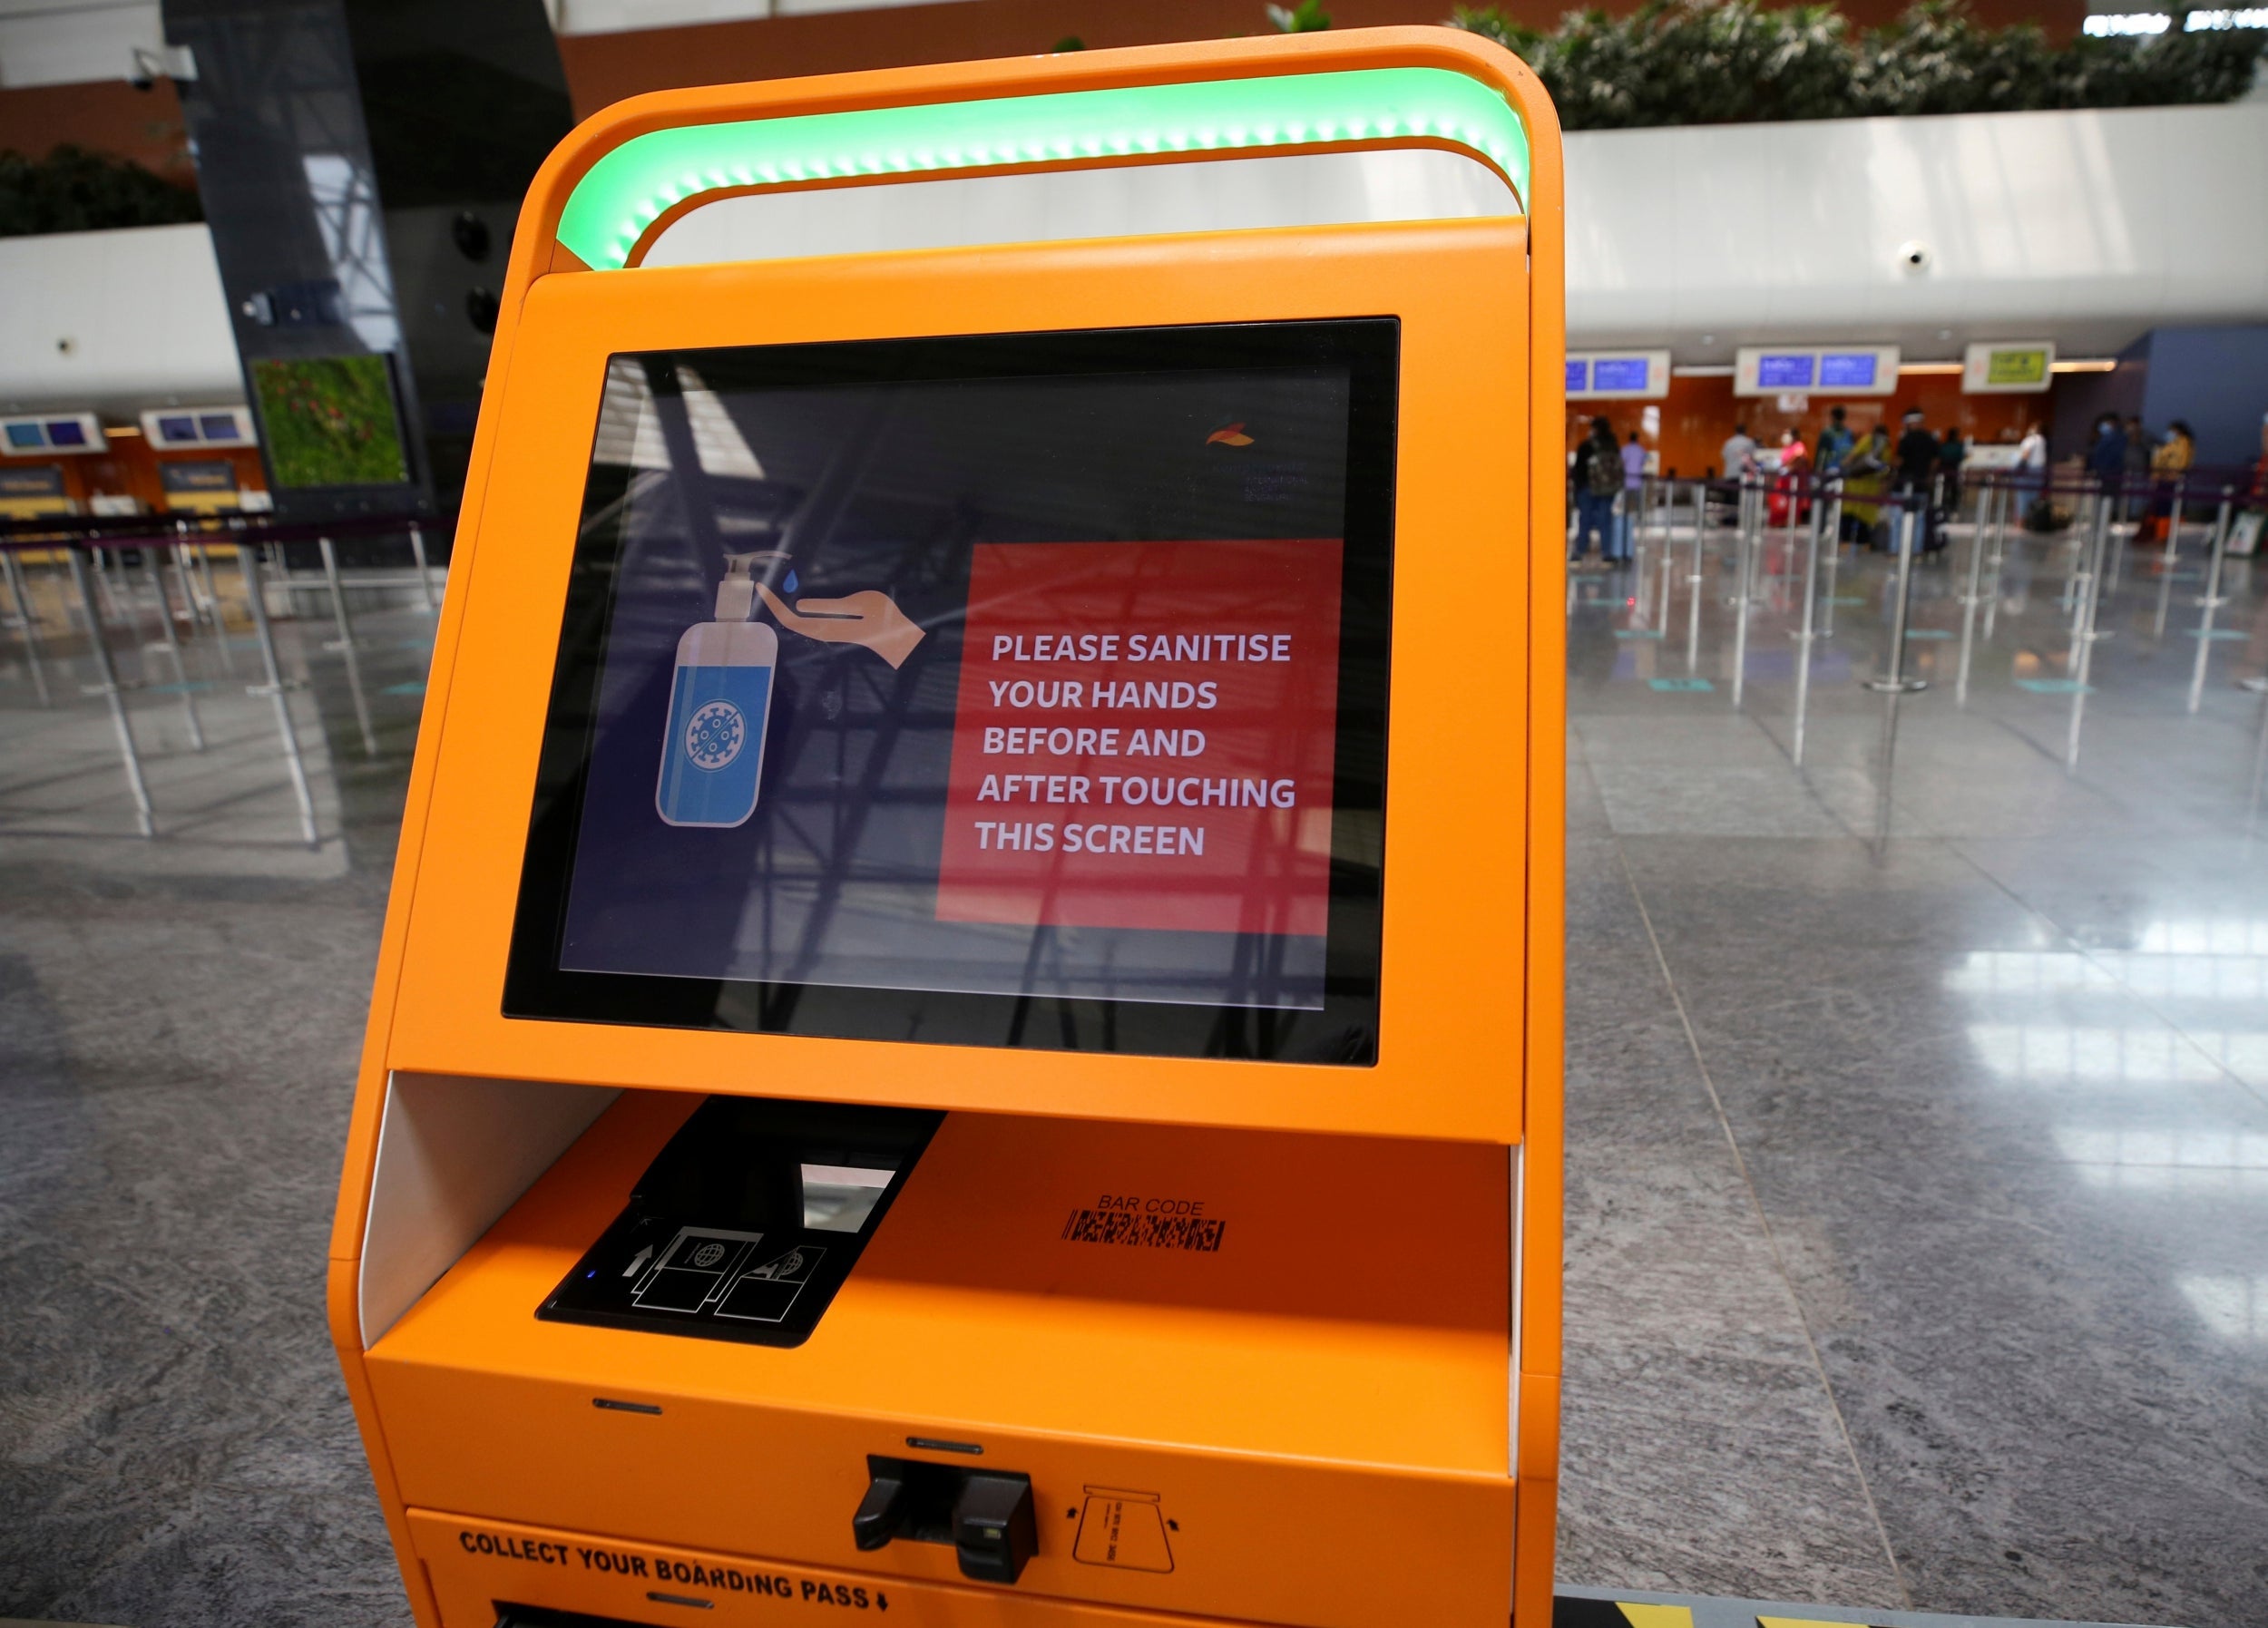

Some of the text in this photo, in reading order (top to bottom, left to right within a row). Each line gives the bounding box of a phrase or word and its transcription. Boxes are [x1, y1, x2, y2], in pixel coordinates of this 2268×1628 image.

[992, 634, 1292, 662] PLEASE SANITISE
[988, 680, 1217, 709] YOUR HANDS
[982, 726, 1206, 756] BEFORE AND
[976, 774, 1295, 808] AFTER TOUCHING
[974, 822, 1205, 855] THIS SCREEN
[1098, 1194, 1205, 1216] BAR CODE
[459, 1531, 568, 1565] COLLECT
[576, 1547, 649, 1578] YOUR
[800, 1580, 869, 1609] PASS
